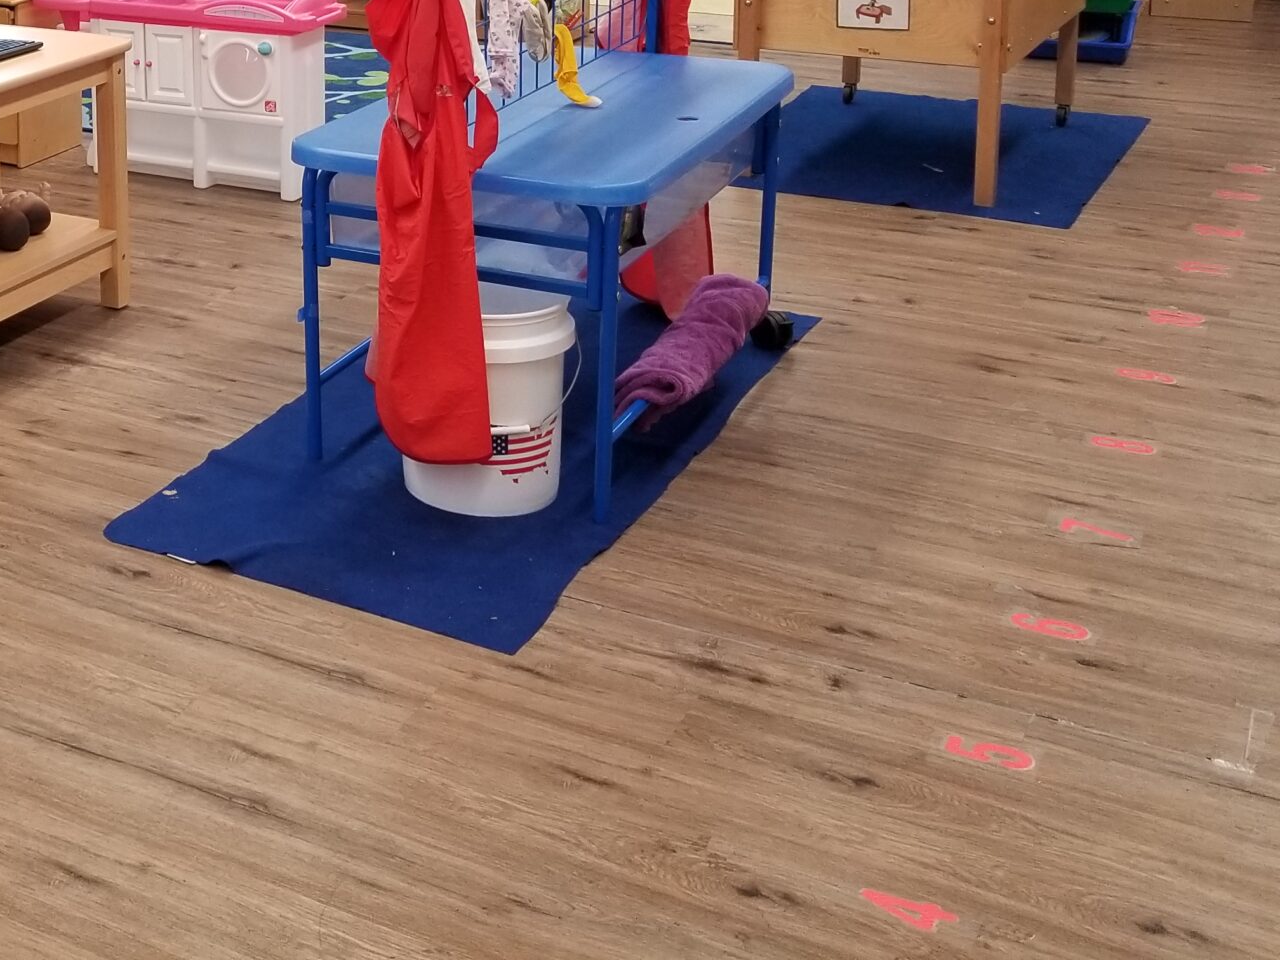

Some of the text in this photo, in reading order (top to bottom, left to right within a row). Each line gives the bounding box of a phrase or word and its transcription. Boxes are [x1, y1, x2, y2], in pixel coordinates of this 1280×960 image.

[1115, 368, 1175, 384] 9
[1091, 436, 1155, 454] 8
[1059, 517, 1134, 541] 7
[1010, 613, 1090, 640] 6
[945, 736, 1035, 770] 5
[860, 888, 959, 931] 4
